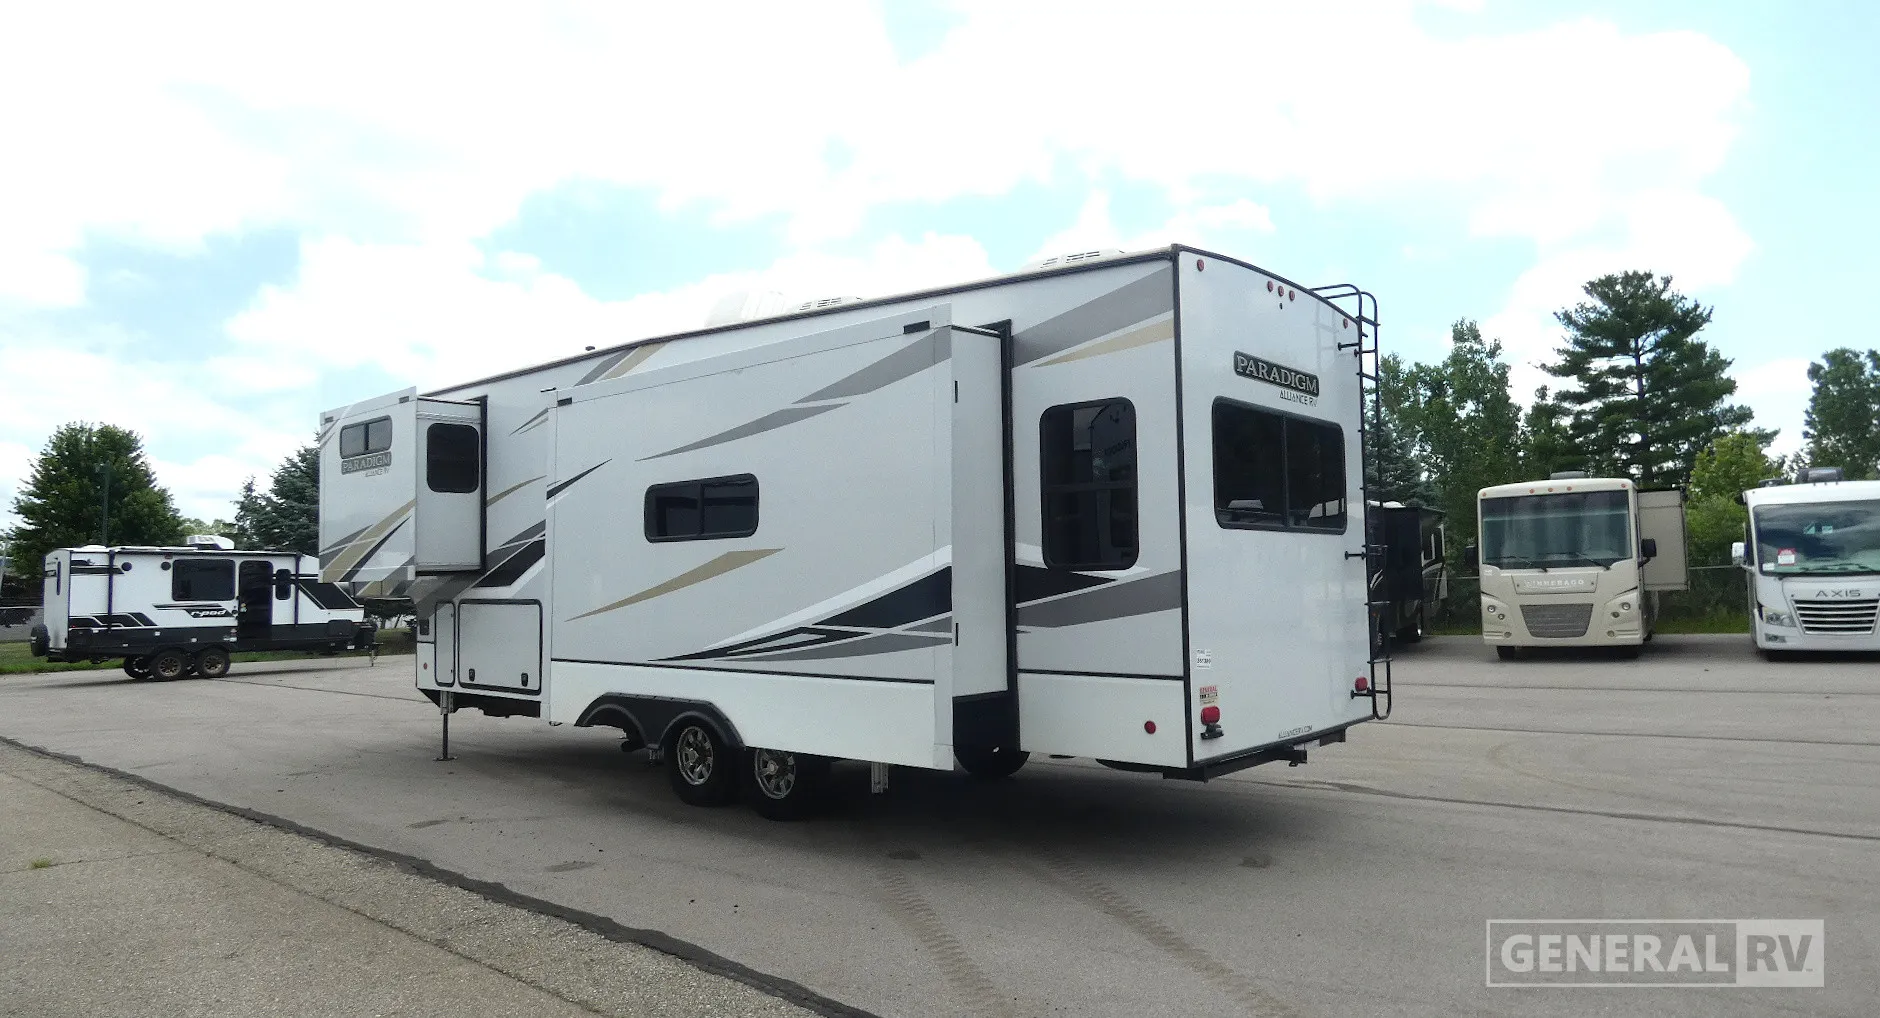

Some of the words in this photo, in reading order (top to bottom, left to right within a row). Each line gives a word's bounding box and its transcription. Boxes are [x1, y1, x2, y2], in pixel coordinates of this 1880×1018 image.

[1236, 354, 1318, 393] PARADIGM
[1280, 389, 1308, 405] ALLIANCE
[1308, 396, 1318, 407] RV
[342, 453, 391, 472] PARADIGM
